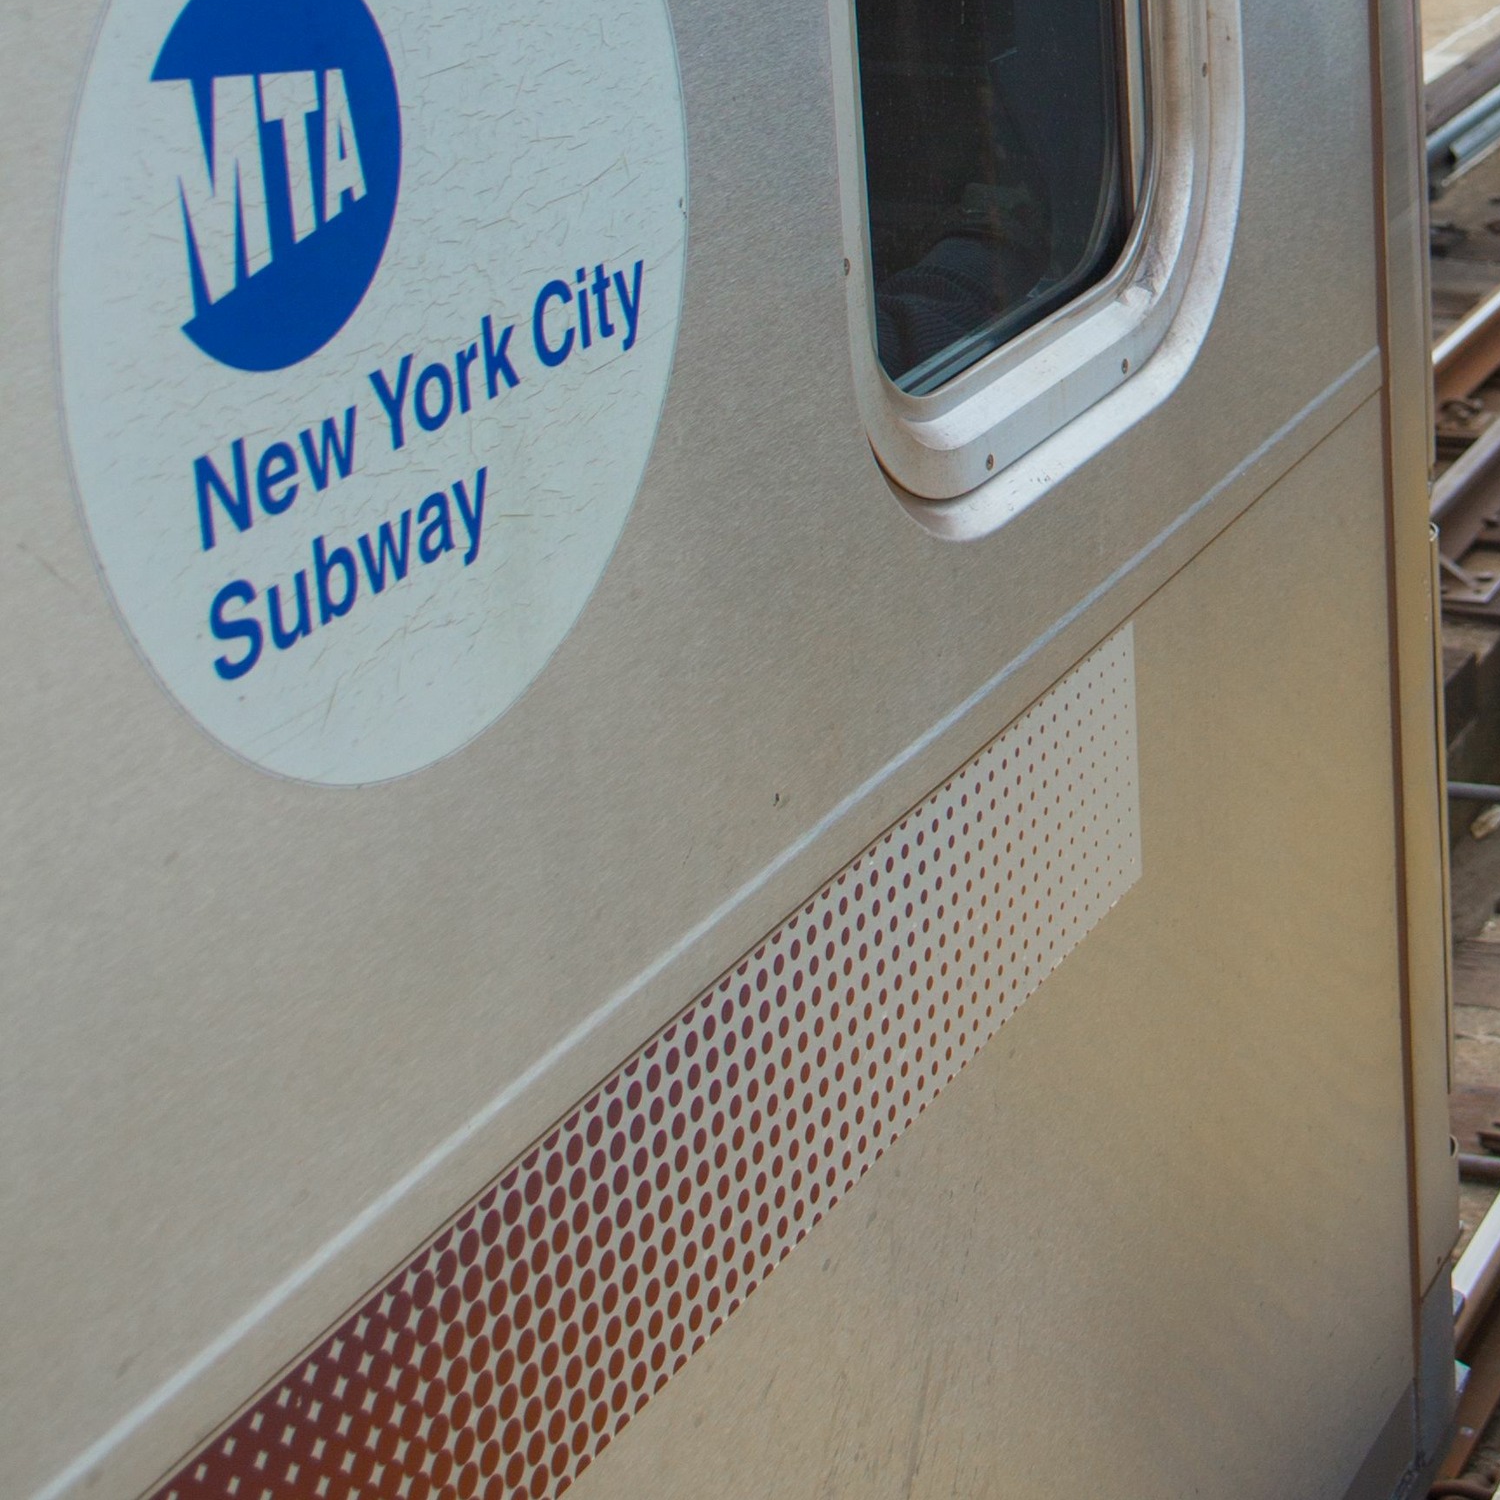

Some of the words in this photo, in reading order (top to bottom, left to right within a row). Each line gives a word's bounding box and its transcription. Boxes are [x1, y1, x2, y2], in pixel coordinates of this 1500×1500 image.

[150, 68, 367, 329] MTA
[193, 405, 358, 552] New
[368, 314, 520, 450] York
[531, 259, 644, 367] City
[208, 466, 489, 681] Subway
